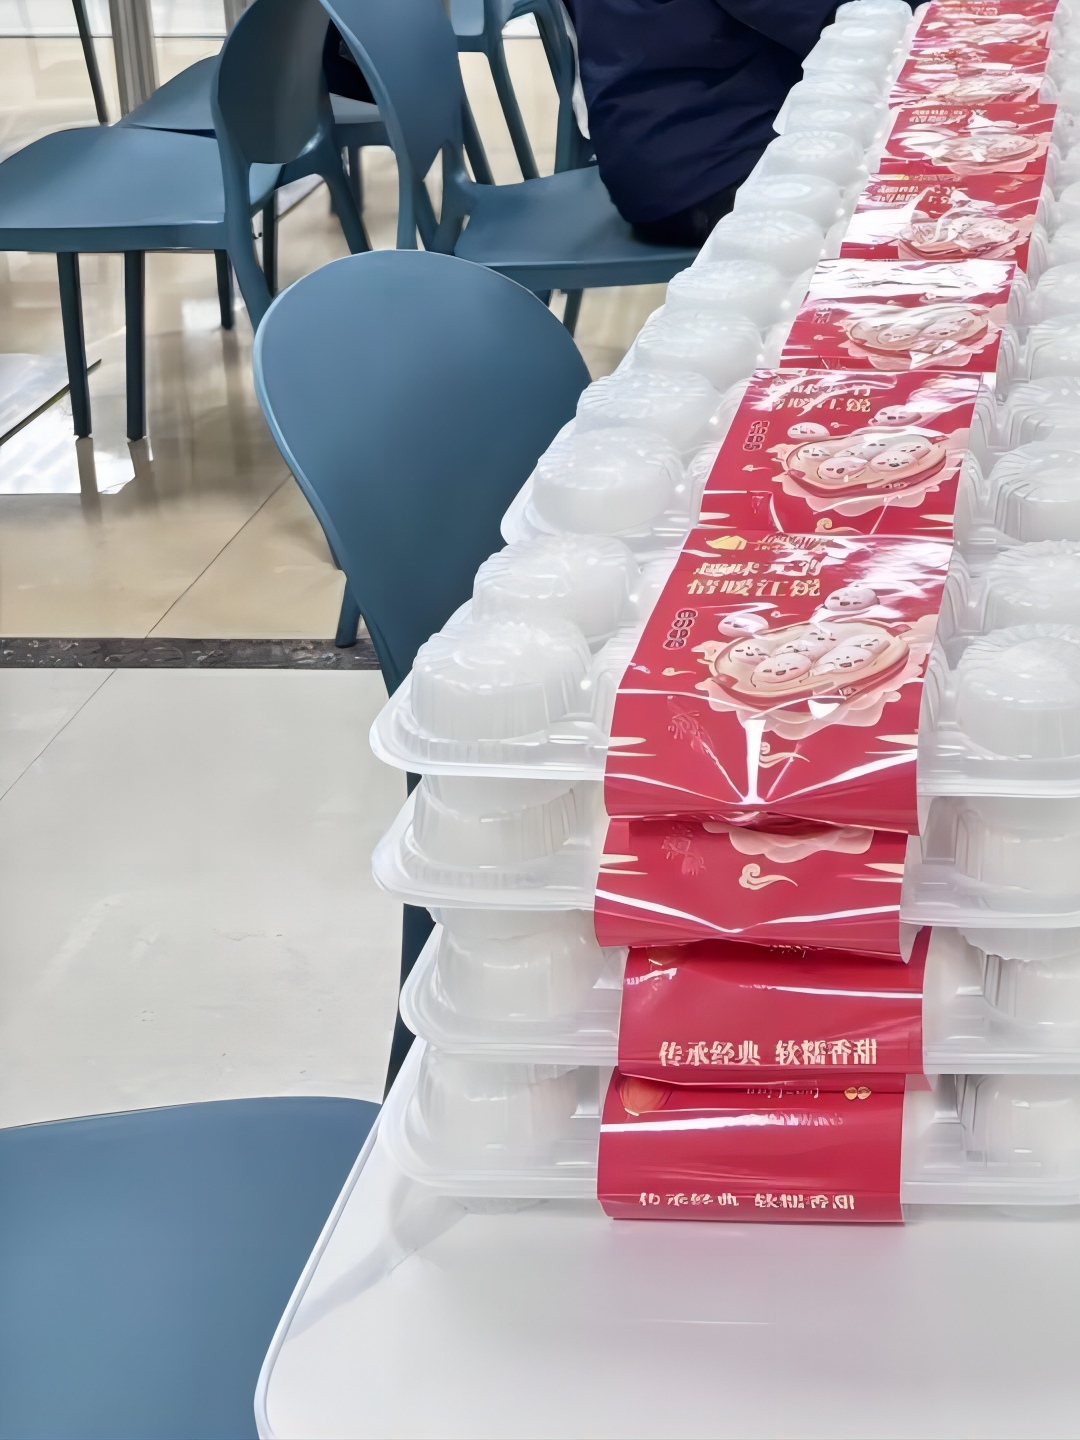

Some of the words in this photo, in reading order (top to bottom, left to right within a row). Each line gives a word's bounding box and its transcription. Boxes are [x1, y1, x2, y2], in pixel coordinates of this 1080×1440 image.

[659, 1040, 761, 1066] 传承经典
[775, 1038, 877, 1065] 软糯香甜
